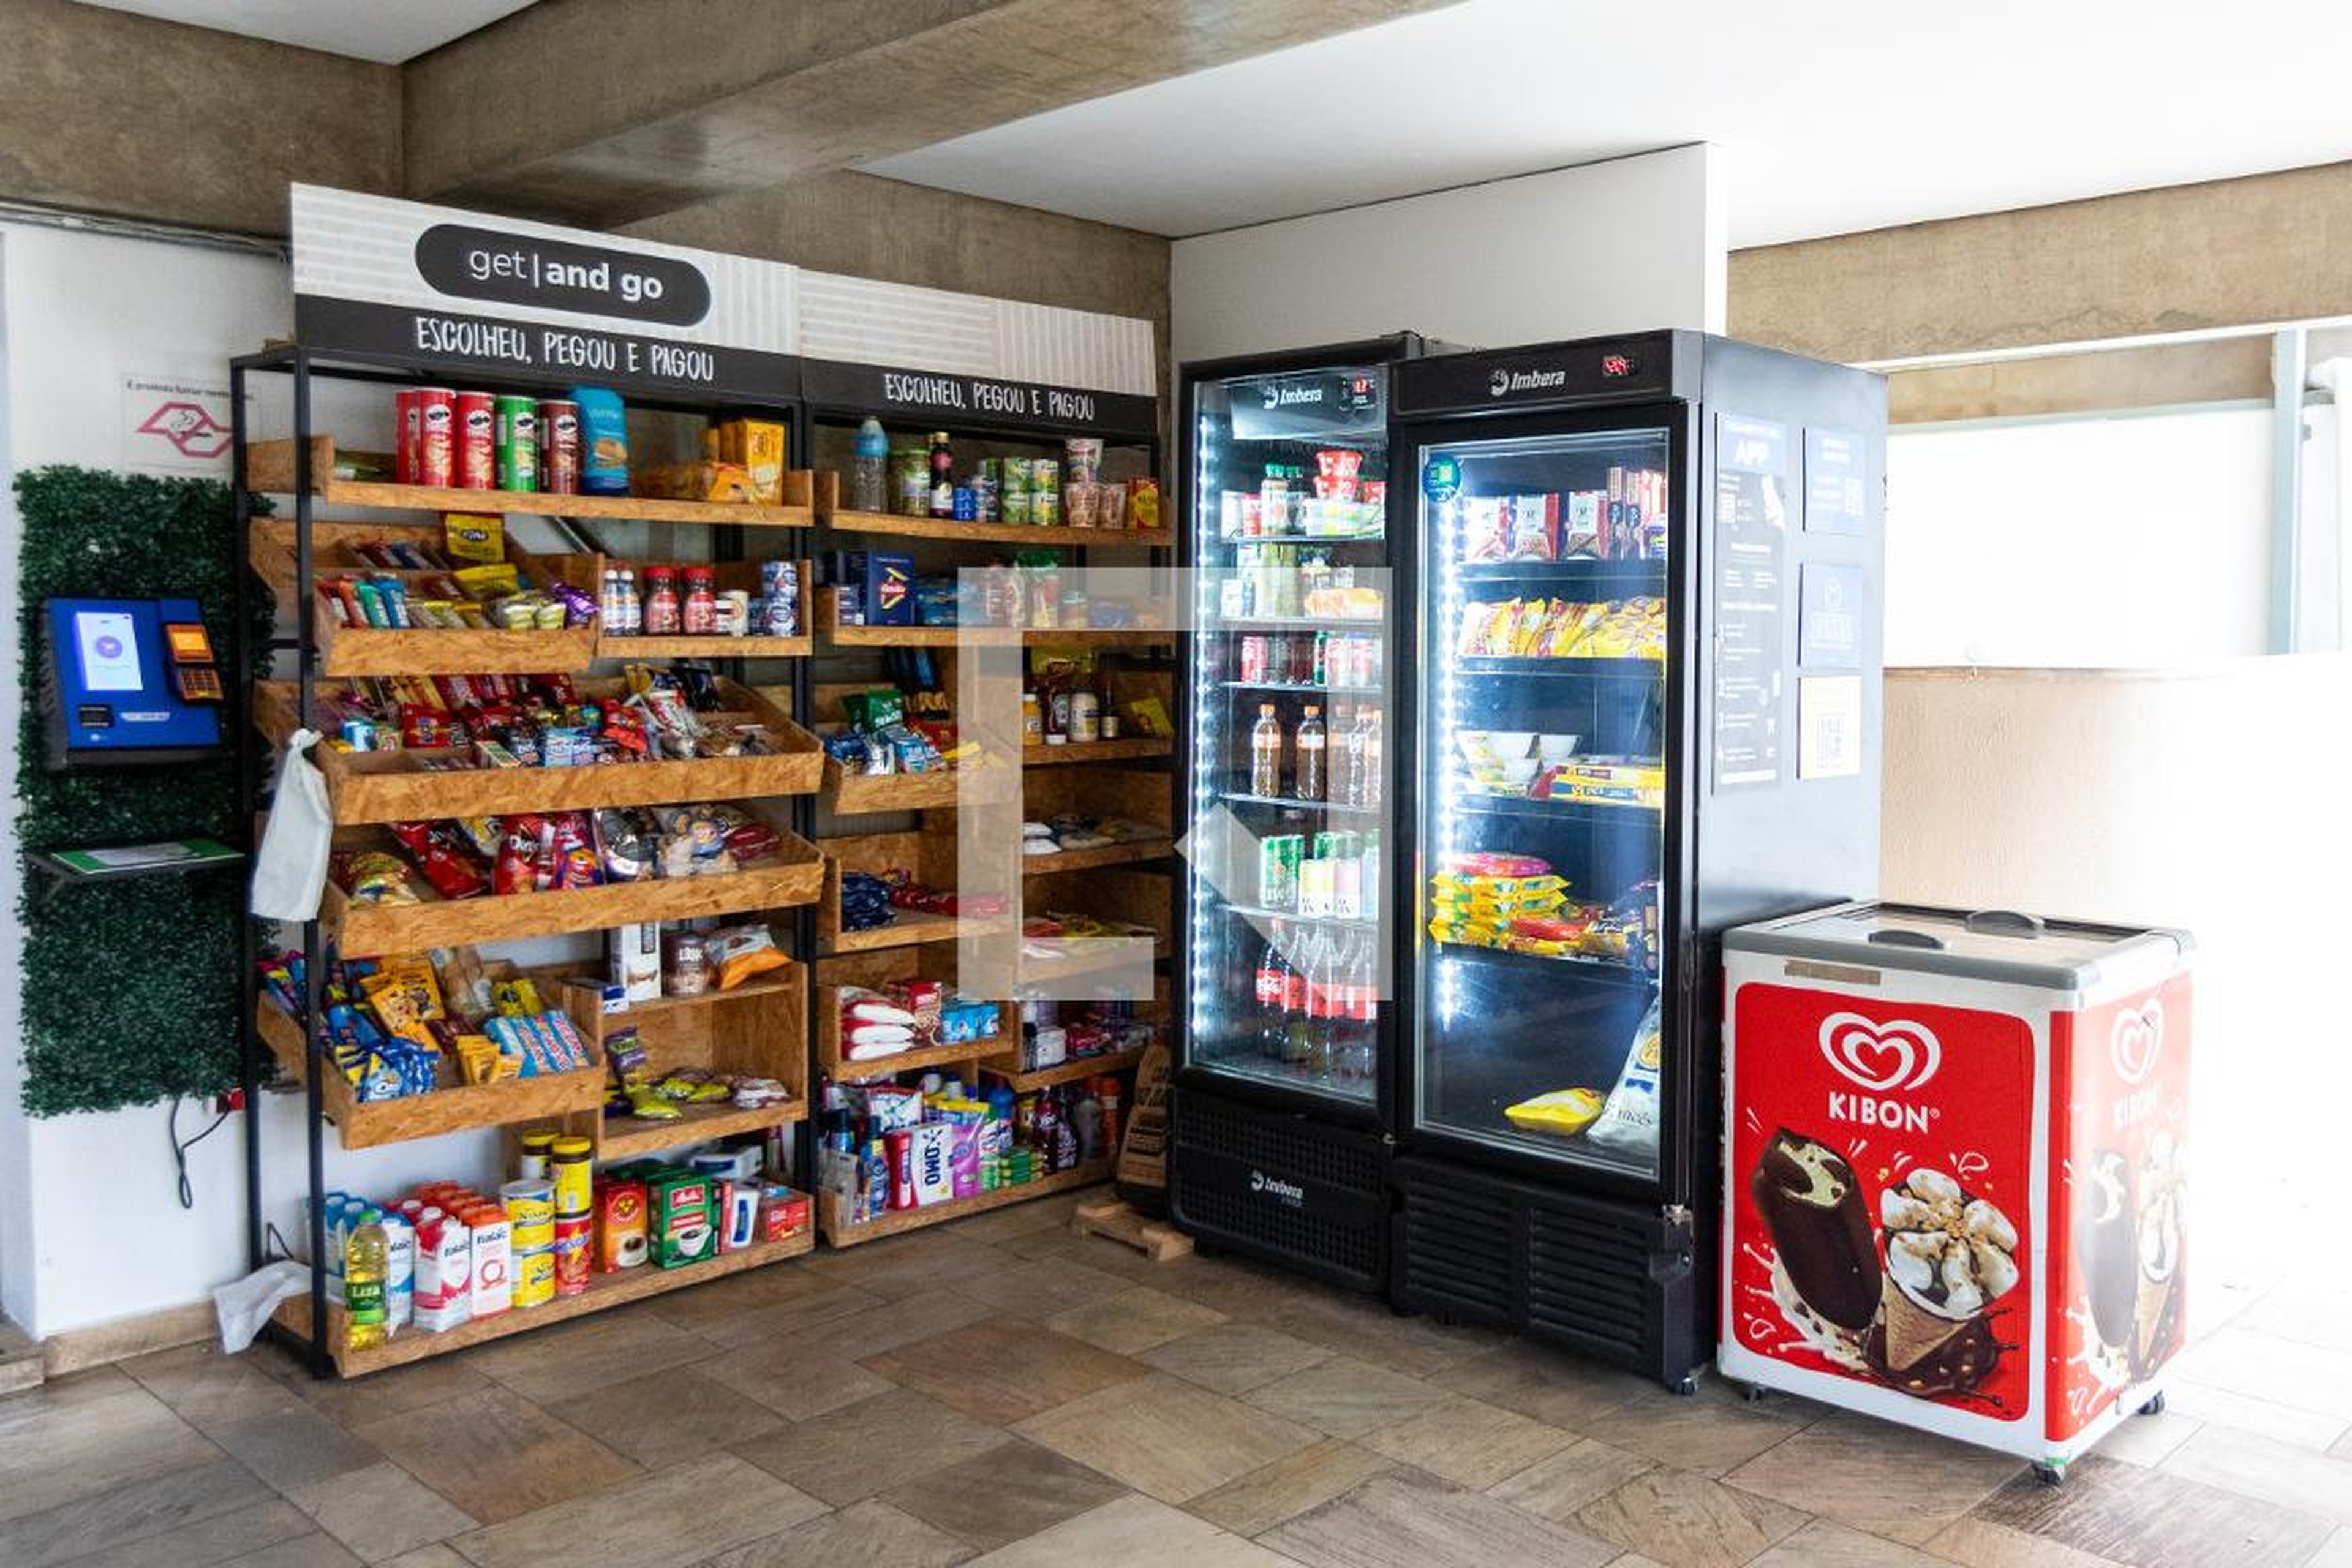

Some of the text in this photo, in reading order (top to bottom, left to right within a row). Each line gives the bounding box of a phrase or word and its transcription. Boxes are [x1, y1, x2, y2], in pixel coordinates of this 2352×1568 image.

[469, 249, 663, 301] get and go
[415, 317, 714, 382] ESCOLHEU, PEGOU E PAGOU
[884, 373, 1095, 421] ESCOLHEU, PEGOU E PAGOU
[1280, 388, 1323, 405] Imbera
[1511, 369, 1566, 391] Imbera
[1828, 1091, 1928, 1134] KIBON
[924, 1145, 941, 1186] OMO
